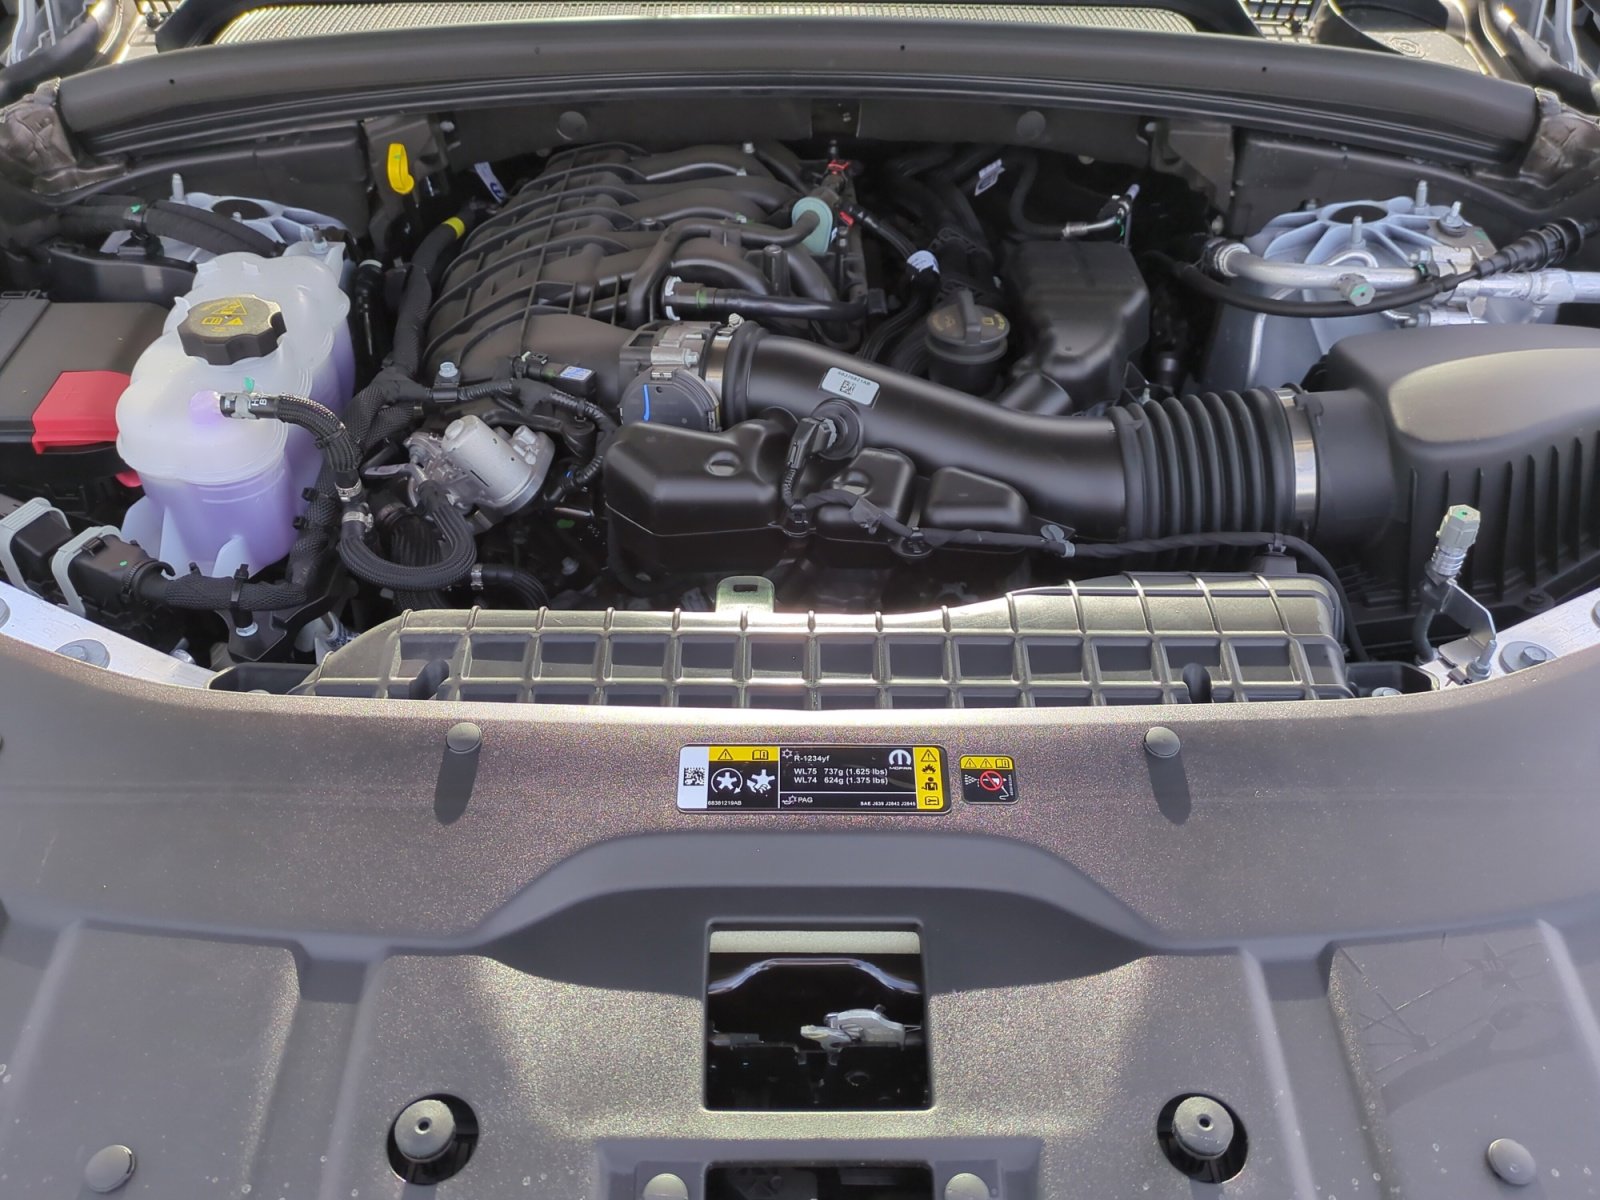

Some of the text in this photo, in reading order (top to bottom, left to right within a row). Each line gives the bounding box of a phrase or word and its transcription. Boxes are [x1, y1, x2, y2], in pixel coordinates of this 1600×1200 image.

[794, 755, 830, 763] R-1234yf
[824, 768, 844, 776] 737g
[845, 768, 871, 777] (1.625
[872, 768, 888, 777] lbs)
[824, 777, 844, 785] 624g
[845, 777, 871, 786] (1.375
[872, 777, 888, 786] lbs)
